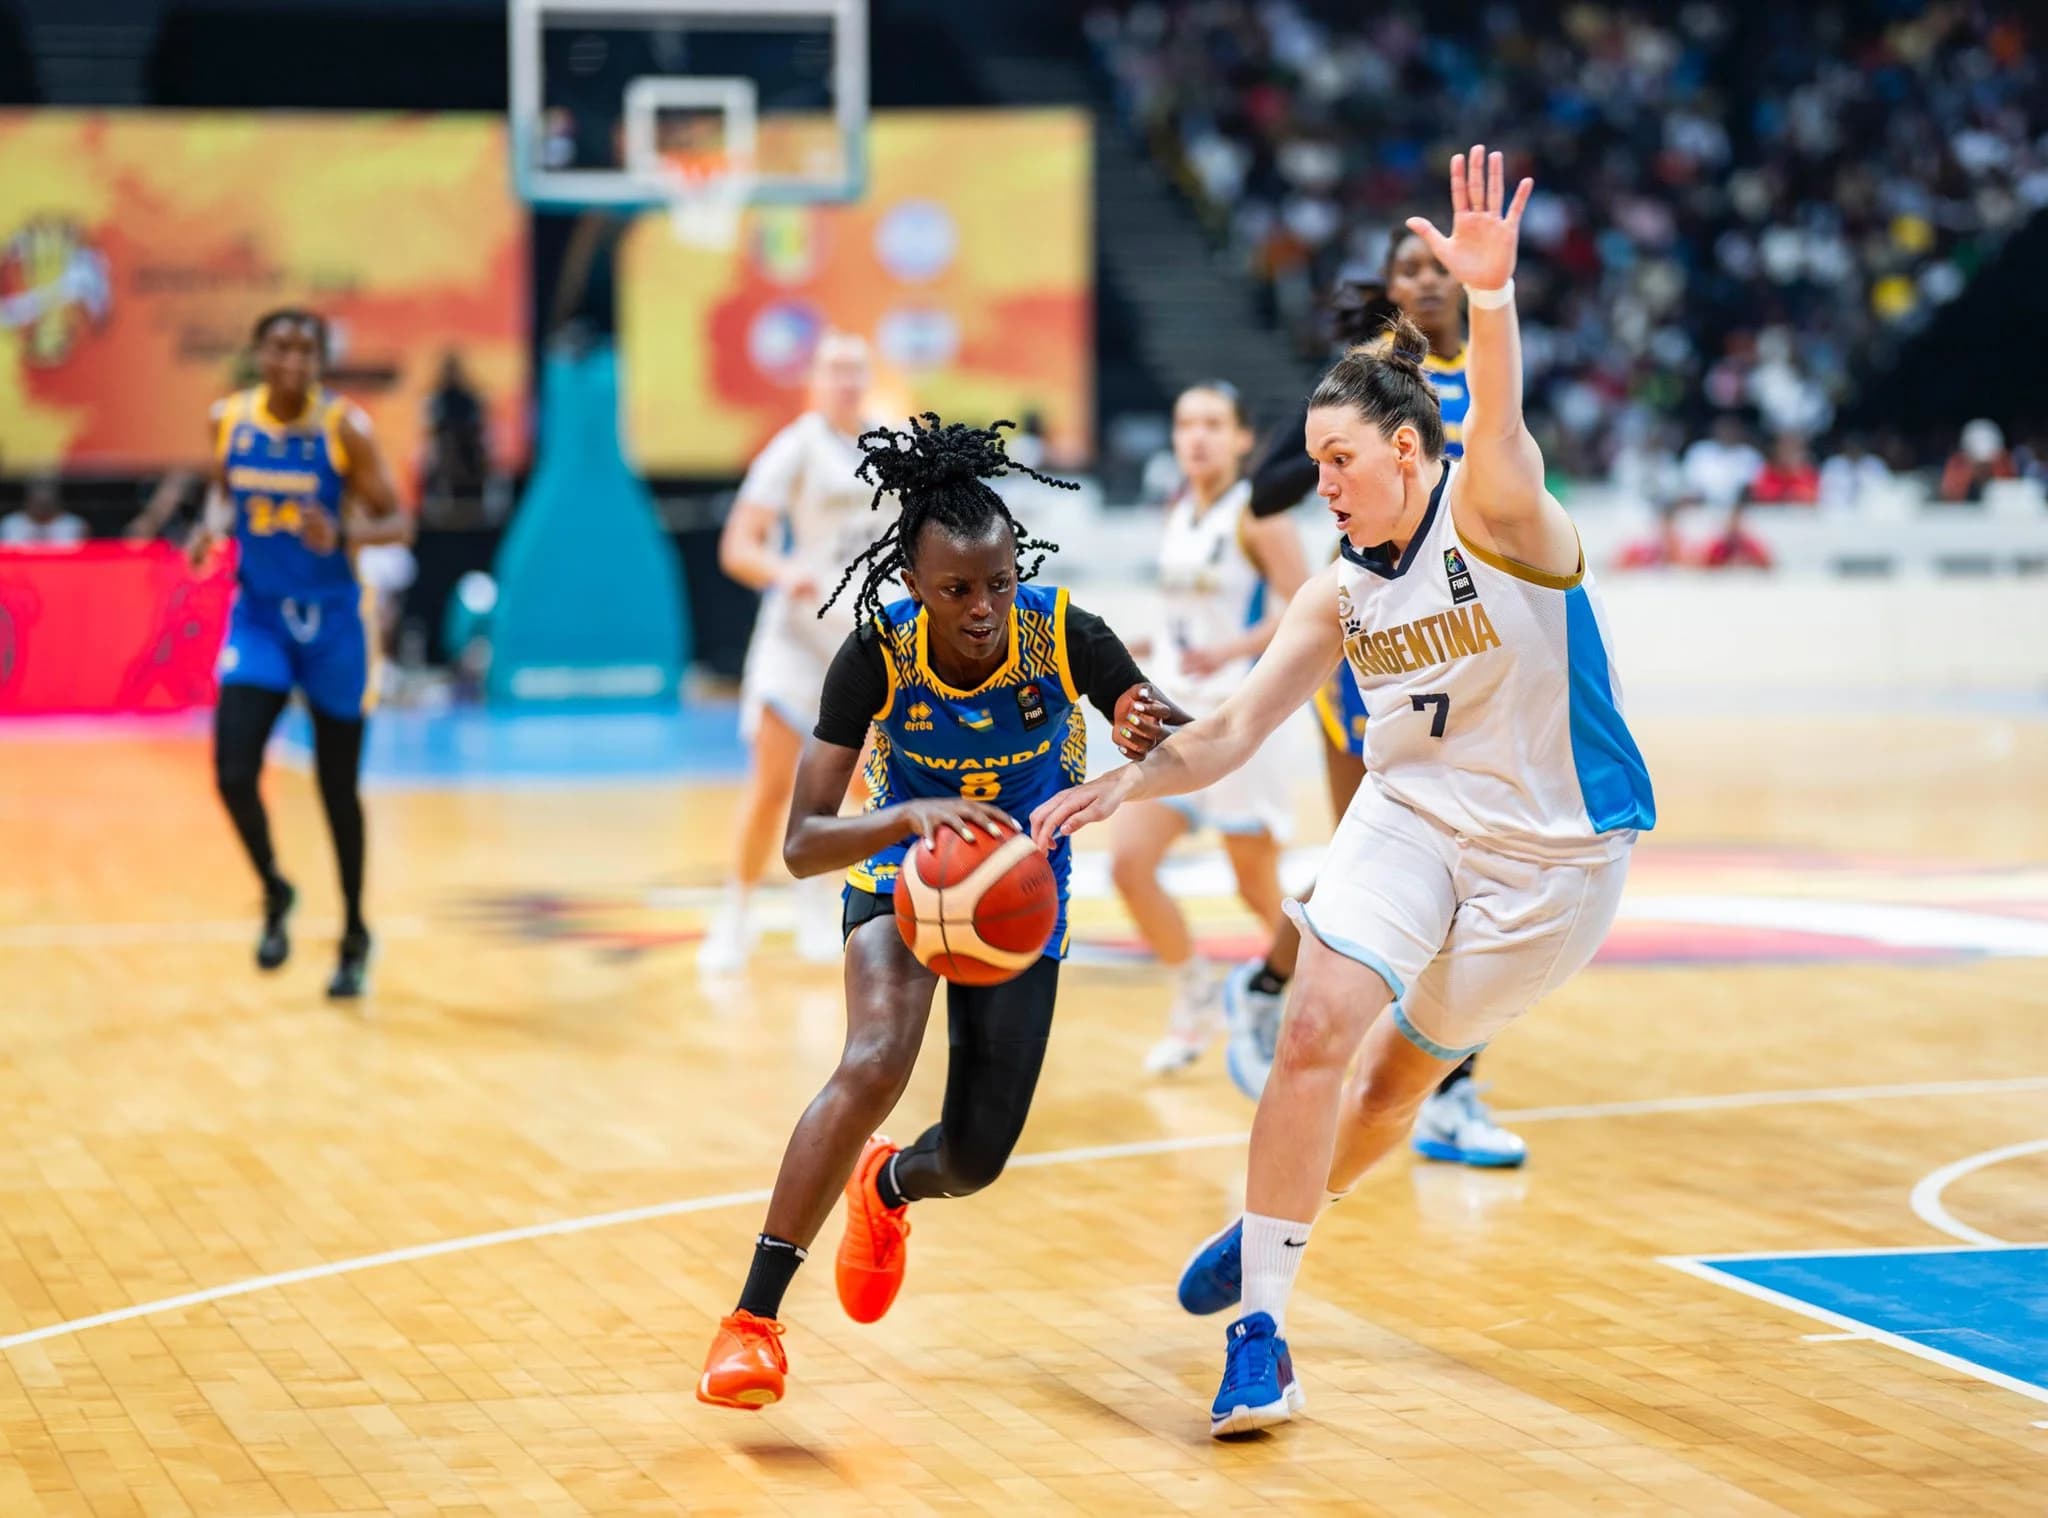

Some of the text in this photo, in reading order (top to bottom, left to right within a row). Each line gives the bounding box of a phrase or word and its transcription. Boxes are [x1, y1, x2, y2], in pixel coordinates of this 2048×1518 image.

[1452, 577, 1470, 590] FIBA
[1344, 603, 1502, 677] ARGENTINA
[1024, 707, 1043, 720] FIBA
[1410, 692, 1450, 738] 7
[960, 772, 1002, 801] 8
